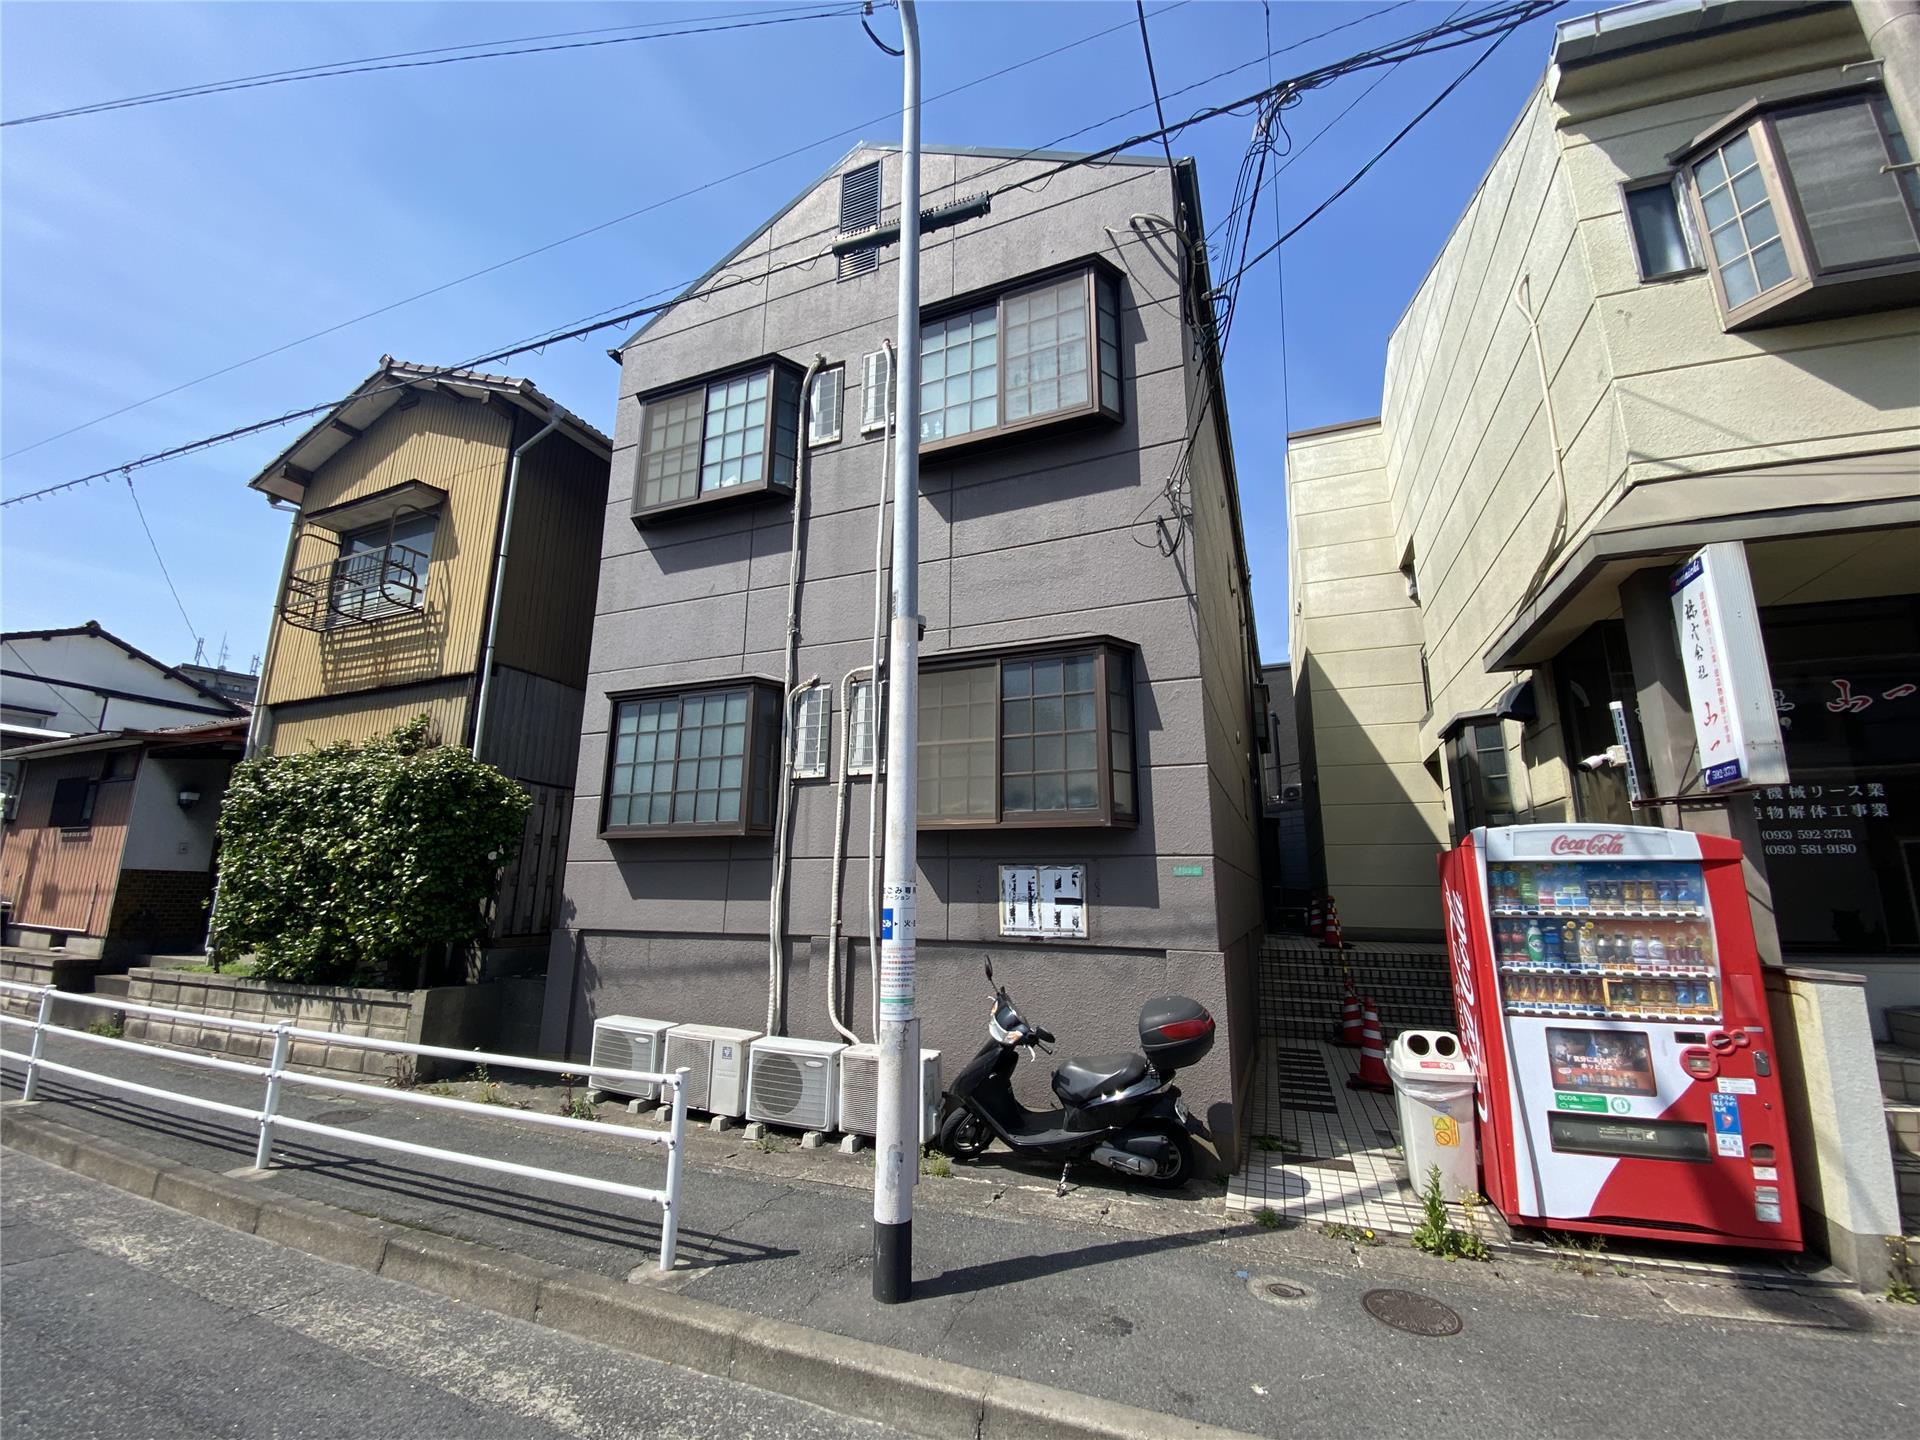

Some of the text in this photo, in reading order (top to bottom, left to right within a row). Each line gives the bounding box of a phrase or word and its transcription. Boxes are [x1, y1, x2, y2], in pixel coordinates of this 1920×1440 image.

[1761, 829, 1853, 841] (093) 592-3731
[1551, 833, 1626, 856] Coca-Cola
[1765, 844, 1857, 855] (093) 581-9180
